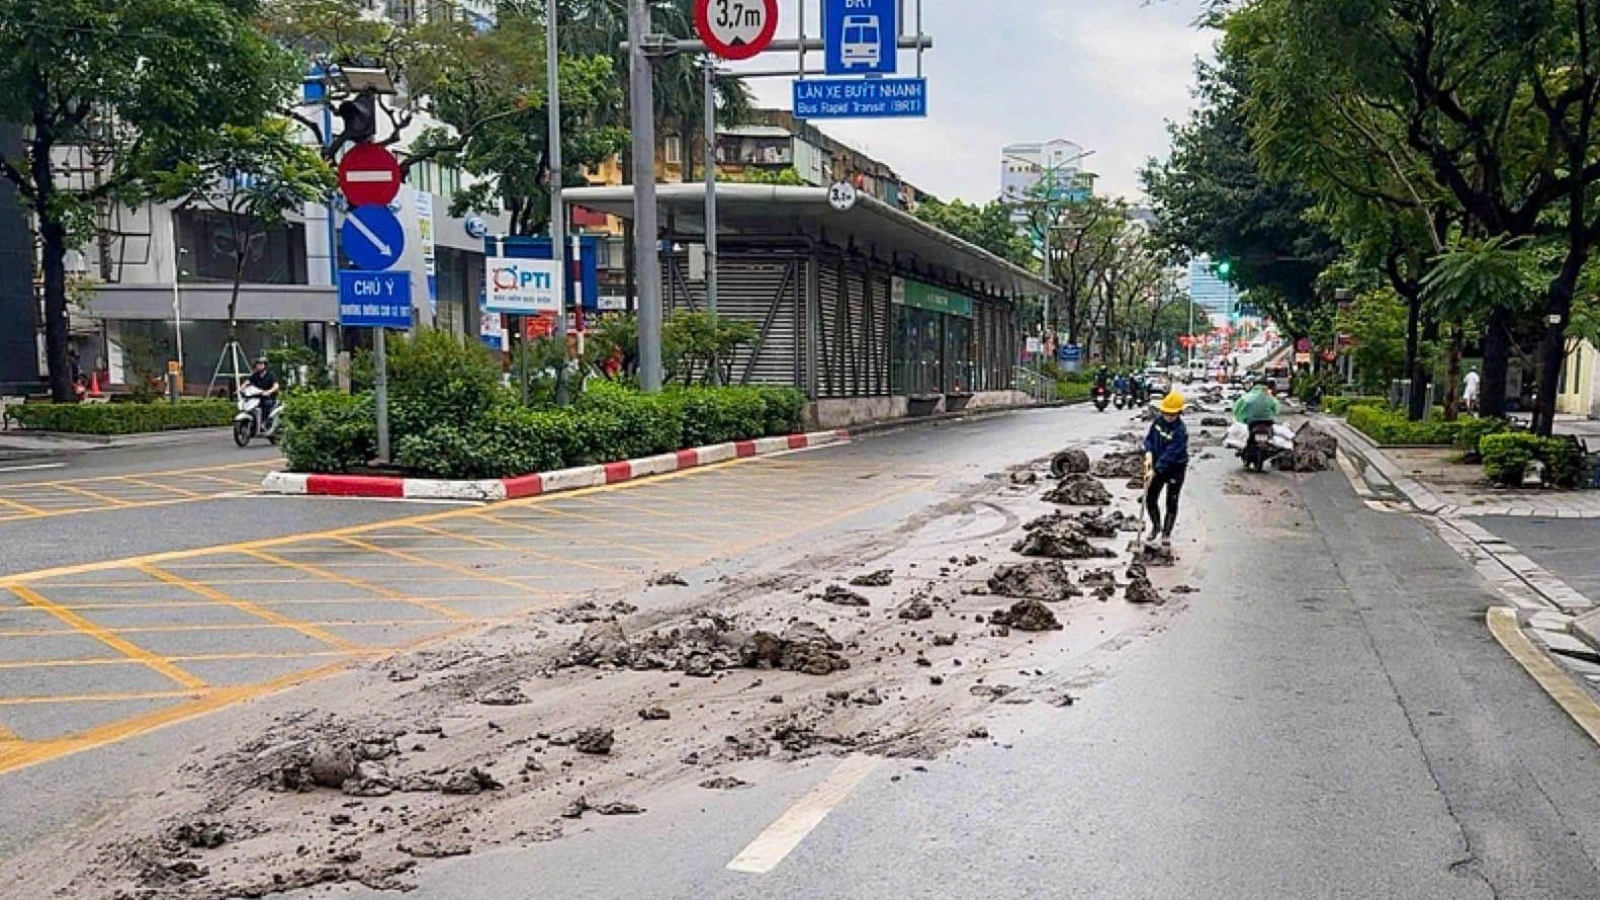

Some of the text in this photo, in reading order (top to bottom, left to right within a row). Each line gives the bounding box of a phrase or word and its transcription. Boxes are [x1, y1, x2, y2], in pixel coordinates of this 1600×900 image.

[826, 85, 842, 99] XE
[880, 84, 922, 97] NHANH
[797, 99, 921, 115] Bus Rapid Transit (BRT)
[354, 277, 380, 296] CHÚ
[520, 271, 551, 289] PTI
